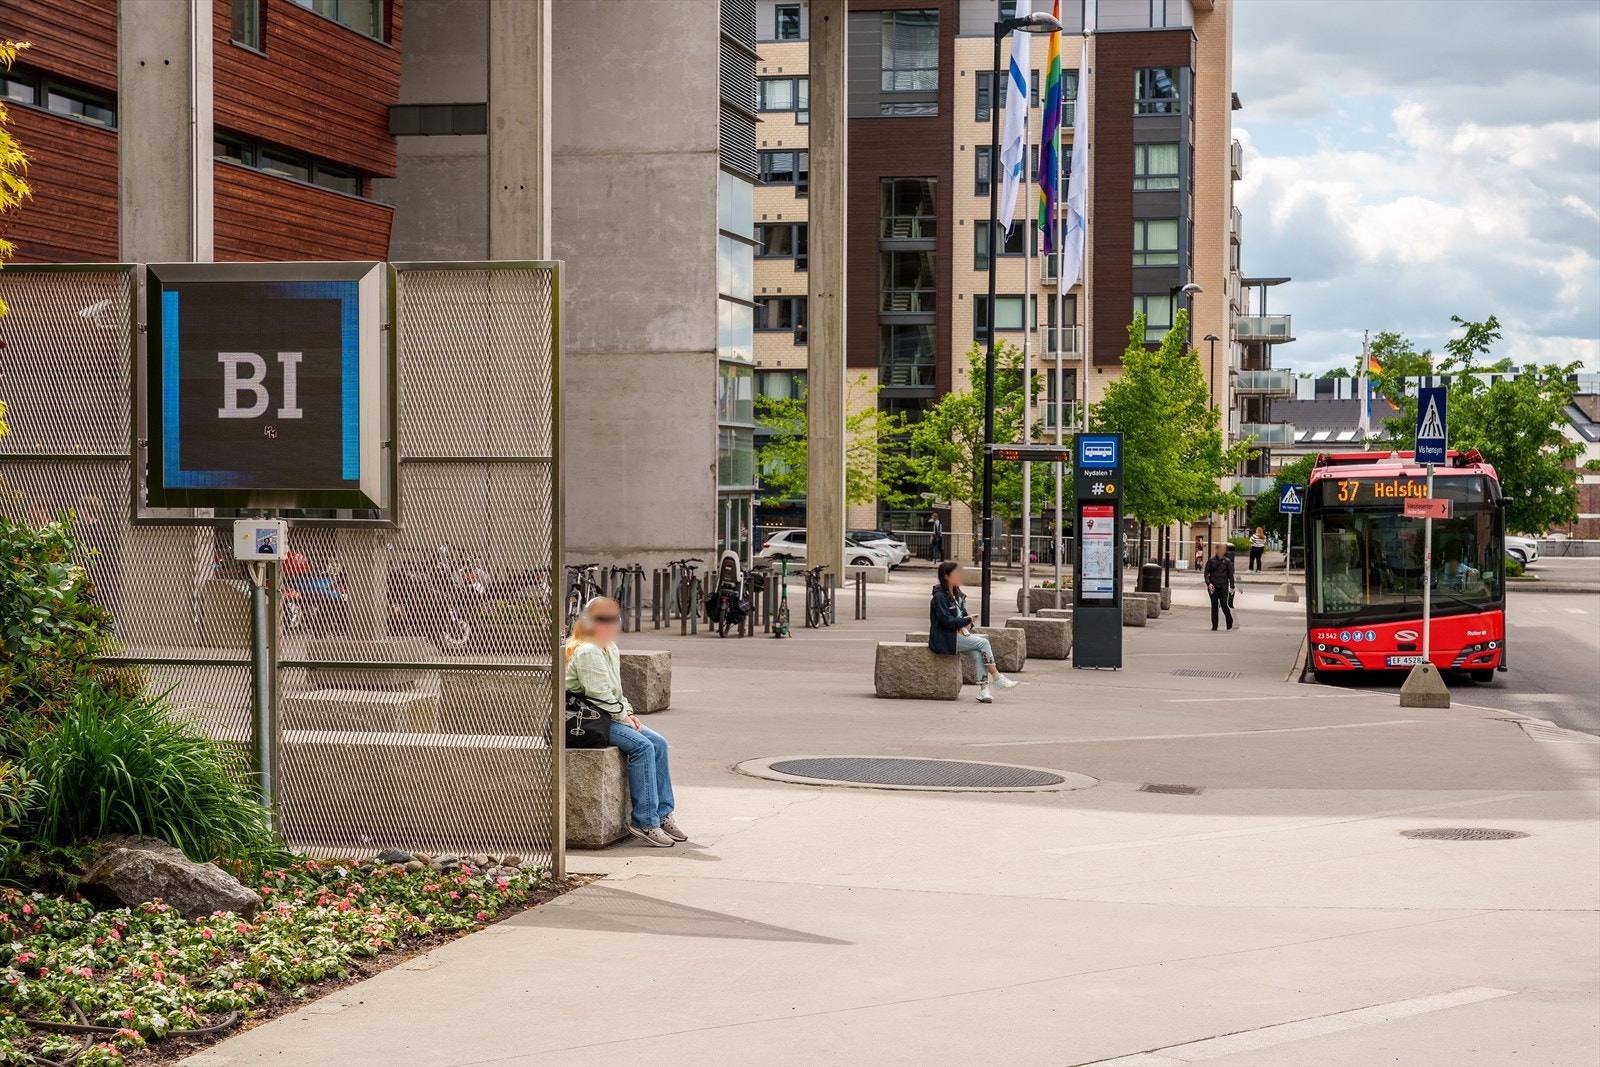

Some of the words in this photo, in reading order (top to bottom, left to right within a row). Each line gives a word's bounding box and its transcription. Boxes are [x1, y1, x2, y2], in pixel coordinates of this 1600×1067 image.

[217, 351, 303, 419] BI
[1418, 446, 1426, 454] Vis
[1426, 445, 1443, 455] hensyn
[1084, 469, 1108, 477] Nydalen
[1337, 481, 1360, 502] 37
[1317, 632, 1325, 640] 23
[1326, 632, 1337, 640] 542
